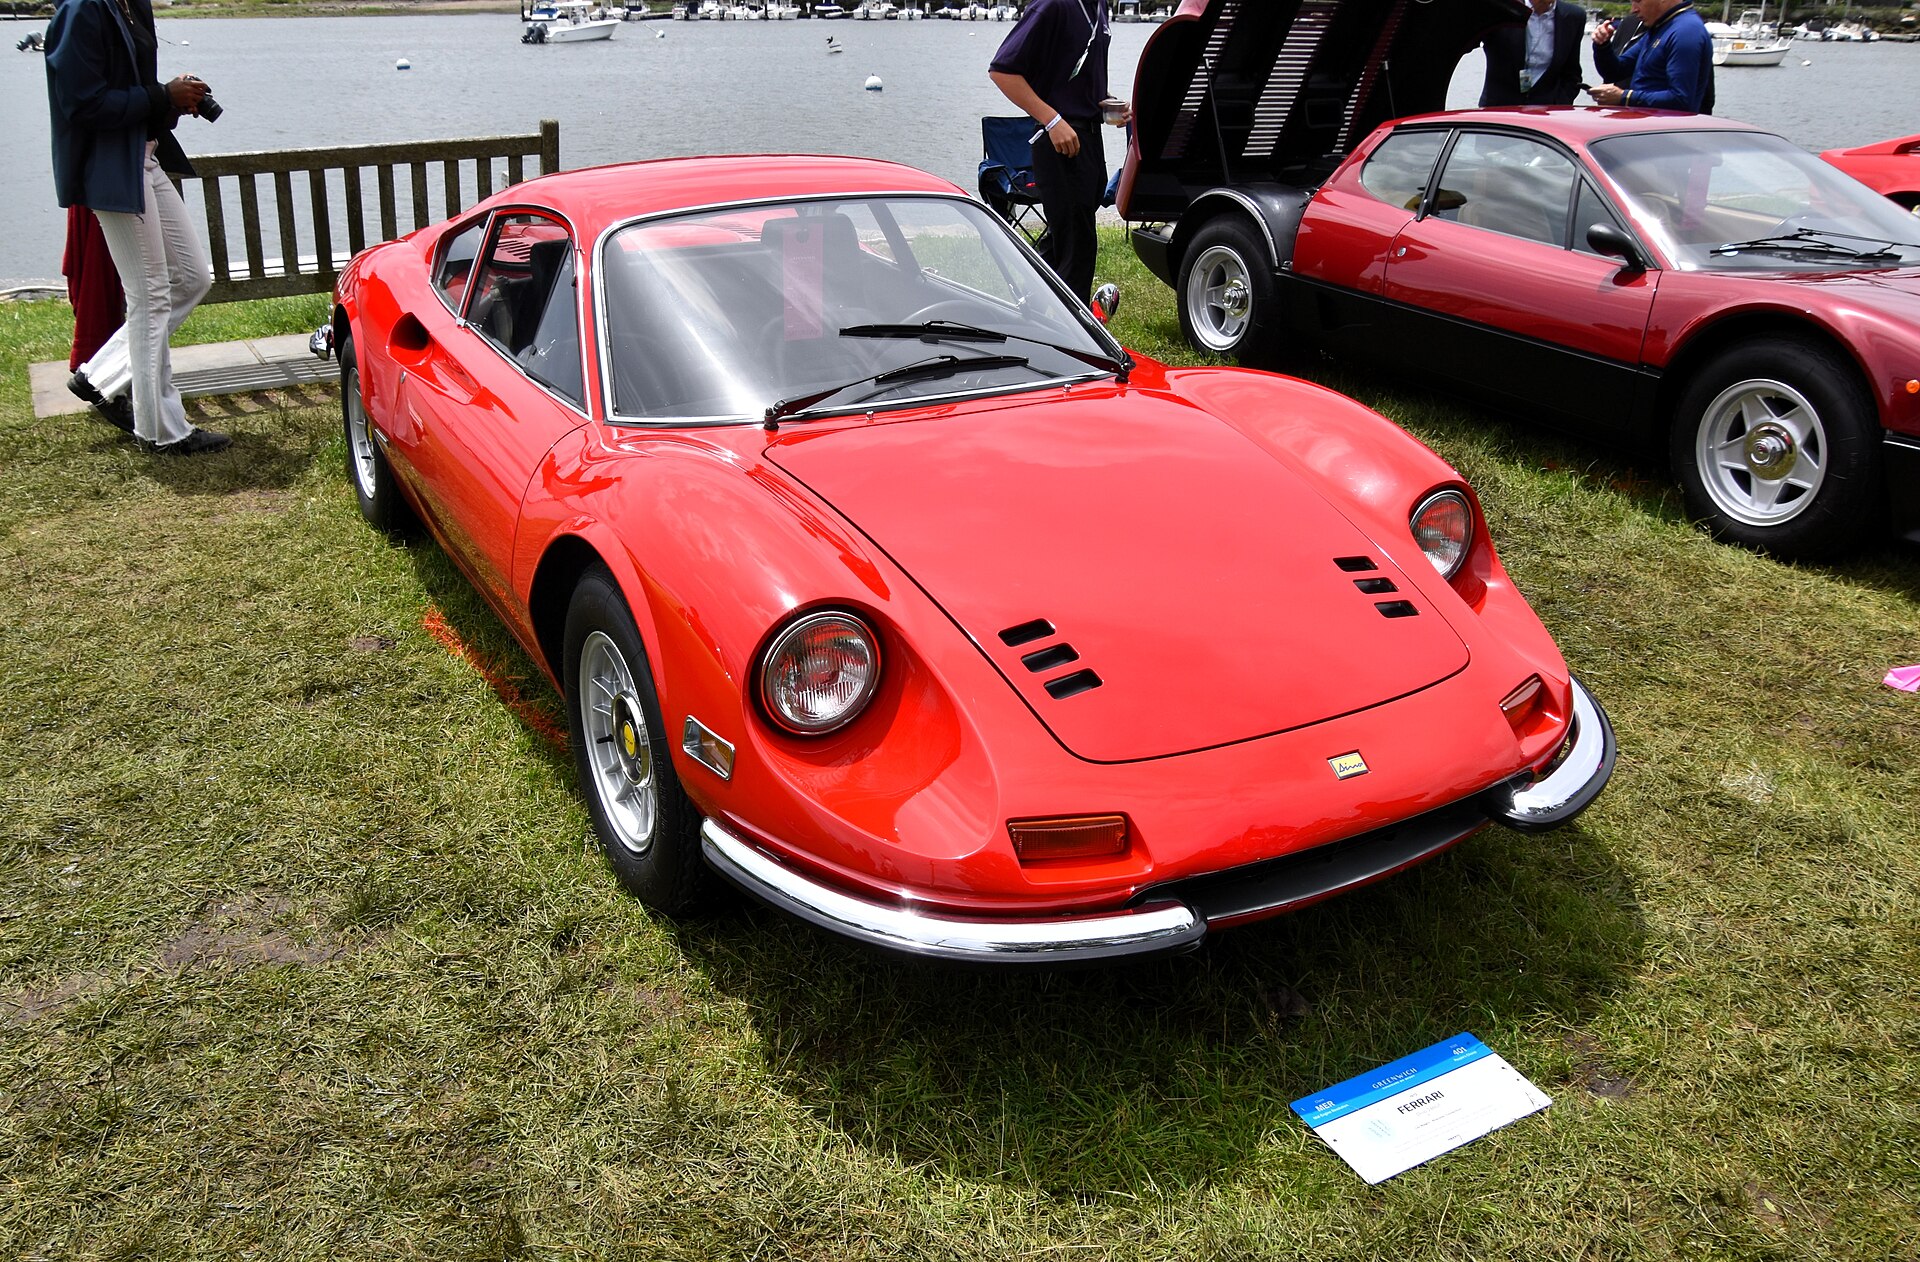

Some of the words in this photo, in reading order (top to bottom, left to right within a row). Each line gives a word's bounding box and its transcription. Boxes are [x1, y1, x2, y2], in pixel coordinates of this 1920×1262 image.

[1339, 762, 1363, 773] Dino
[1452, 1046, 1468, 1055] 401
[1372, 1067, 1418, 1089] GREENWICH
[1314, 1100, 1336, 1112] MER
[1397, 1090, 1445, 1115] FERRARI
